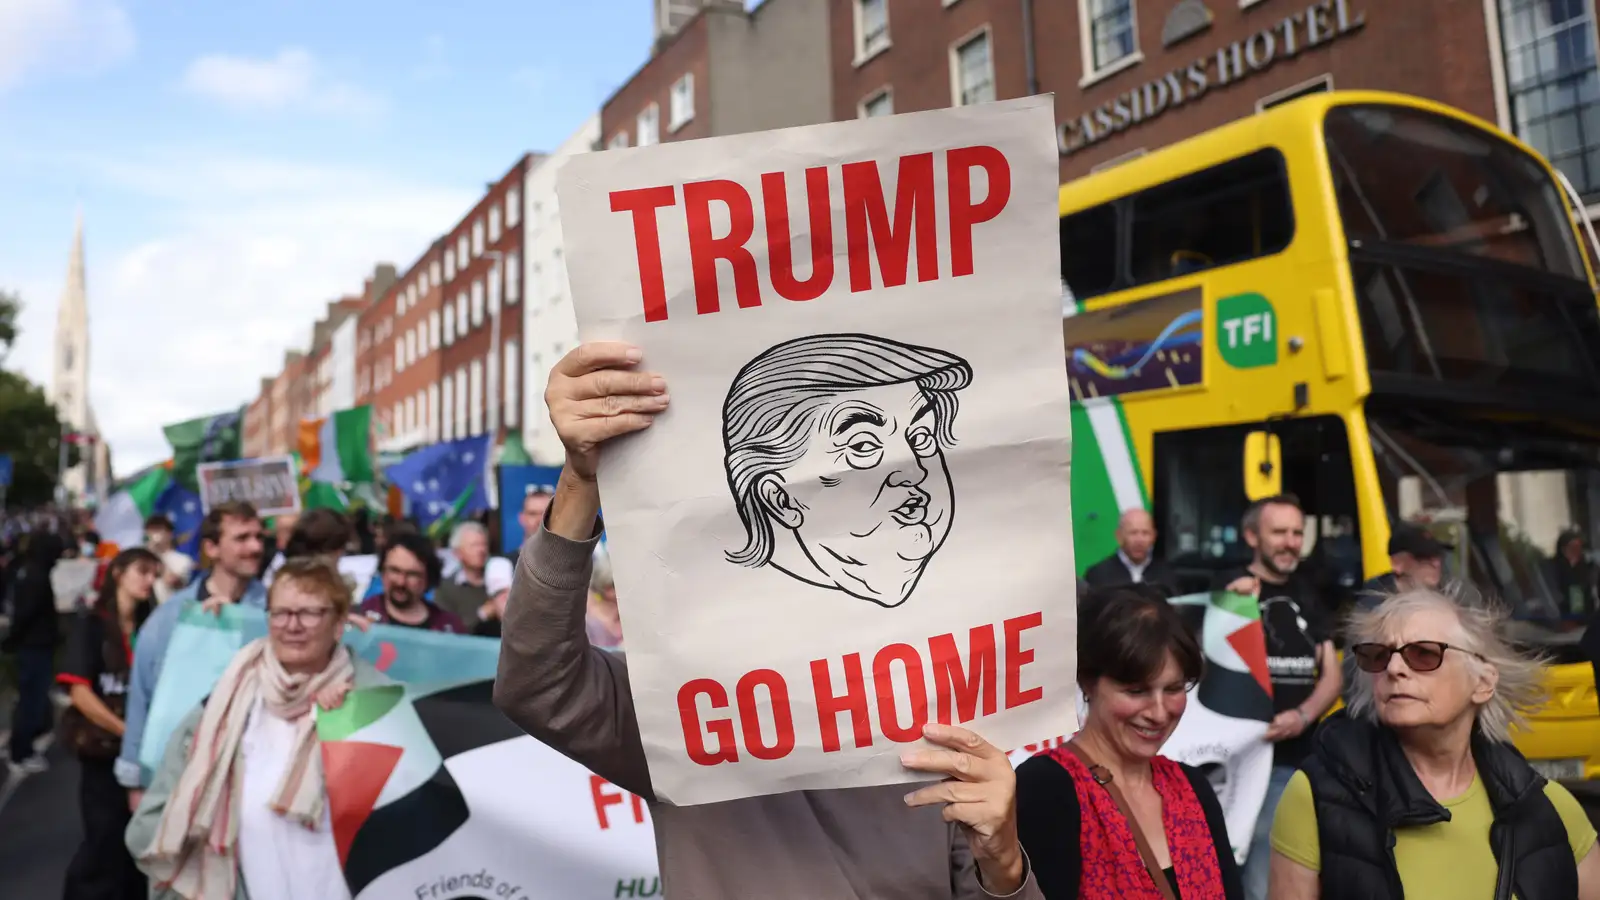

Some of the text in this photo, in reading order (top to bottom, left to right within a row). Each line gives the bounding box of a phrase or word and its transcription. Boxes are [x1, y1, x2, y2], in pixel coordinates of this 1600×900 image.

[1057, 0, 1366, 154] CASSIDYS HOTEL
[609, 145, 1011, 322] TRUMP
[1223, 311, 1271, 348] TFI
[677, 611, 1043, 766] GO HOME
[414, 868, 522, 900] Friends of
